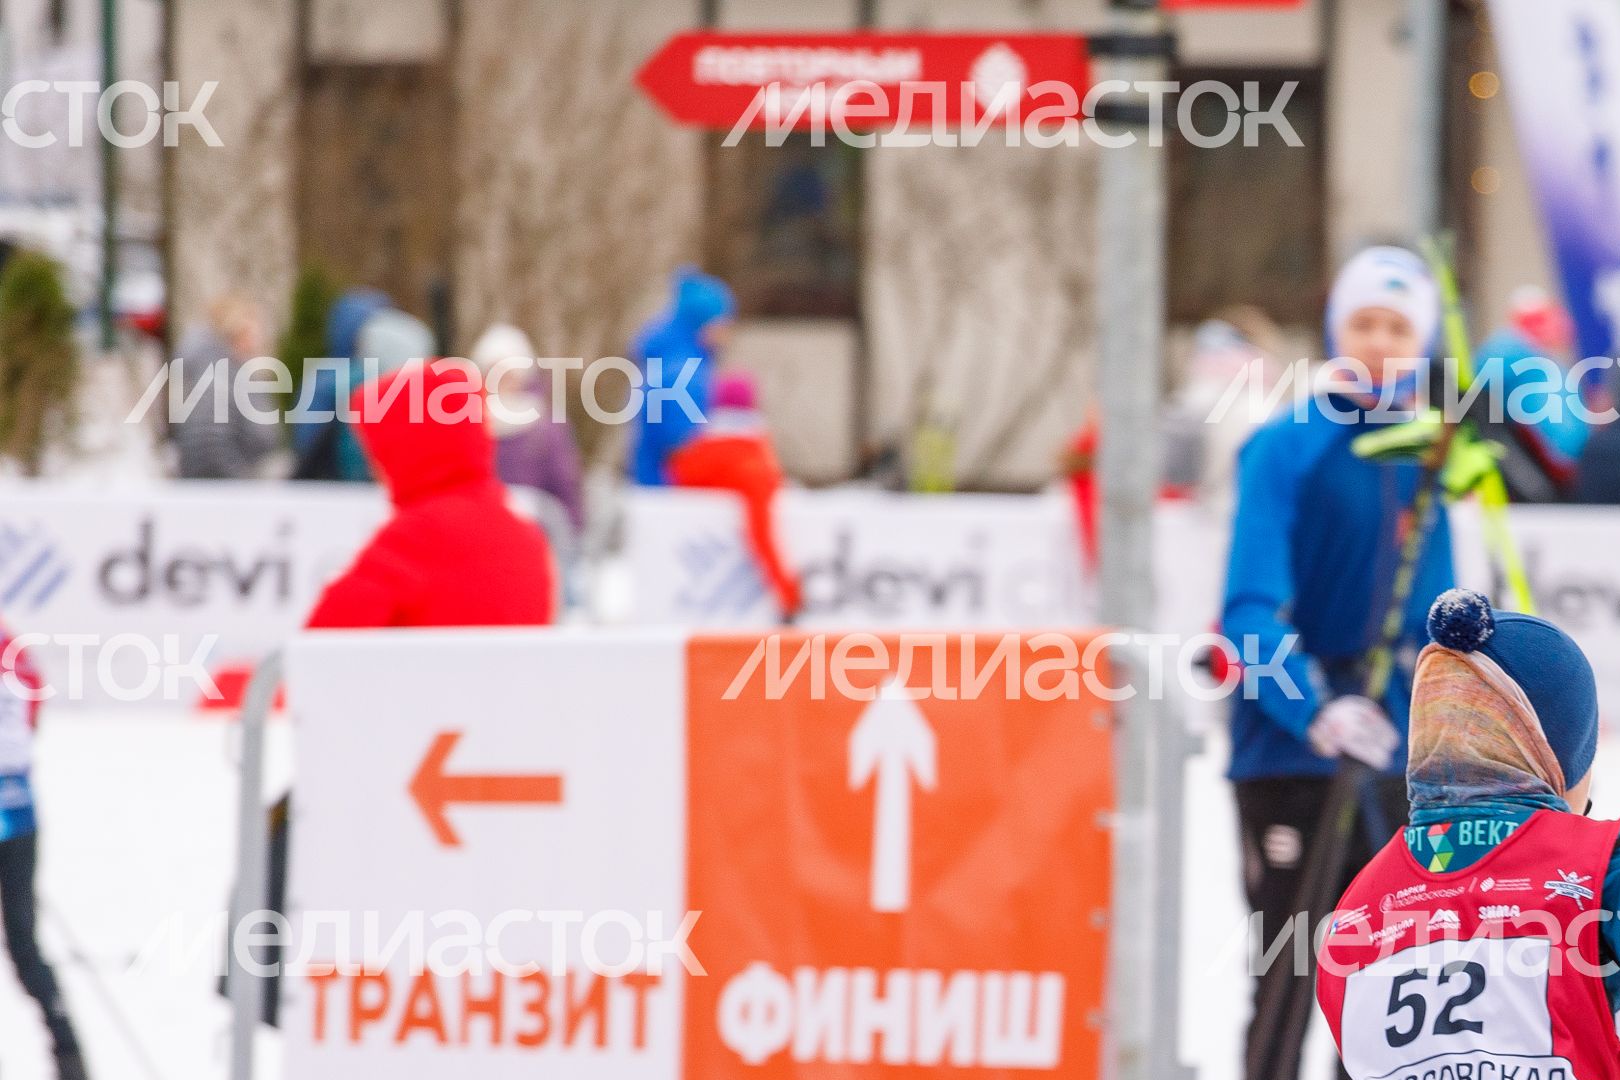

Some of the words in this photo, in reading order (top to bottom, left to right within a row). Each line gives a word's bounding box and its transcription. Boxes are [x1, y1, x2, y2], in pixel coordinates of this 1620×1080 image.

[96, 514, 293, 608] devi
[1403, 825, 1426, 852] РТ
[306, 970, 661, 1050] ТРАНЗИТ
[716, 961, 1066, 1069] ФИНИШ
[1385, 960, 1486, 1048] 52
